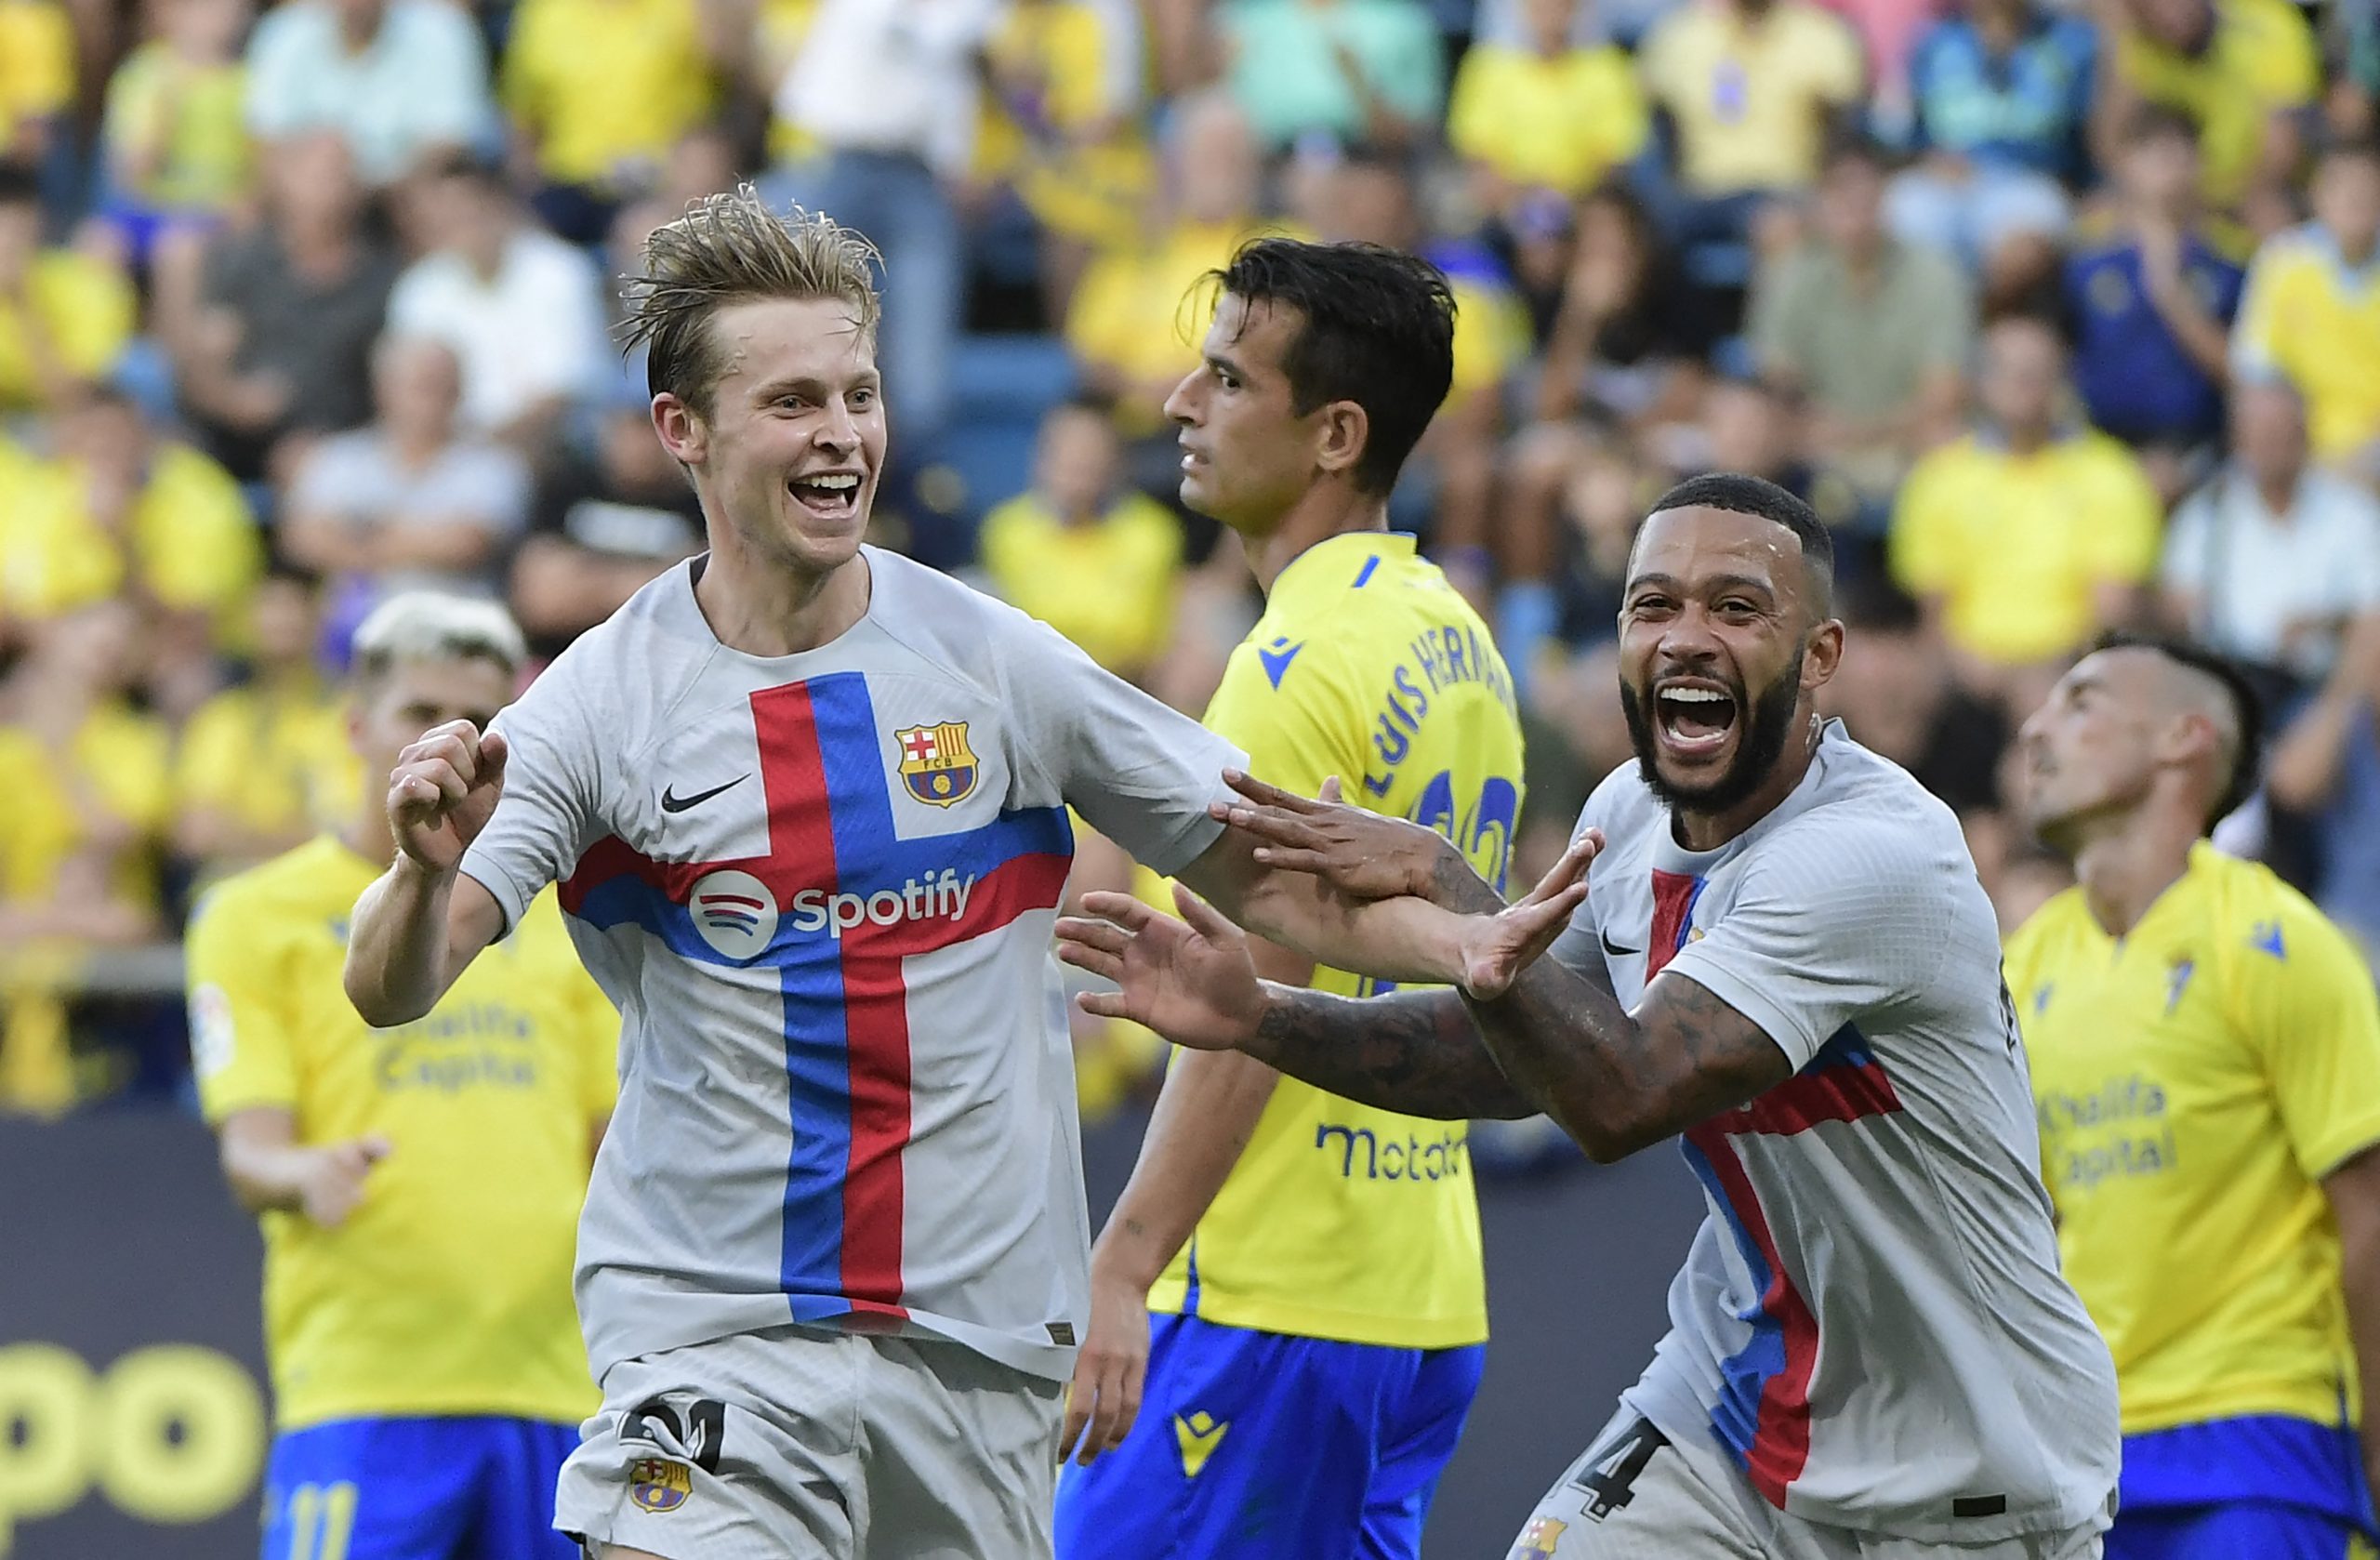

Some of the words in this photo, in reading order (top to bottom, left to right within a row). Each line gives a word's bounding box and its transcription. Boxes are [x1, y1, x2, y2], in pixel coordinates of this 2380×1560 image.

[923, 757, 953, 771] FCB
[1364, 664, 1428, 800] LUIS
[792, 867, 975, 938] Spotify
